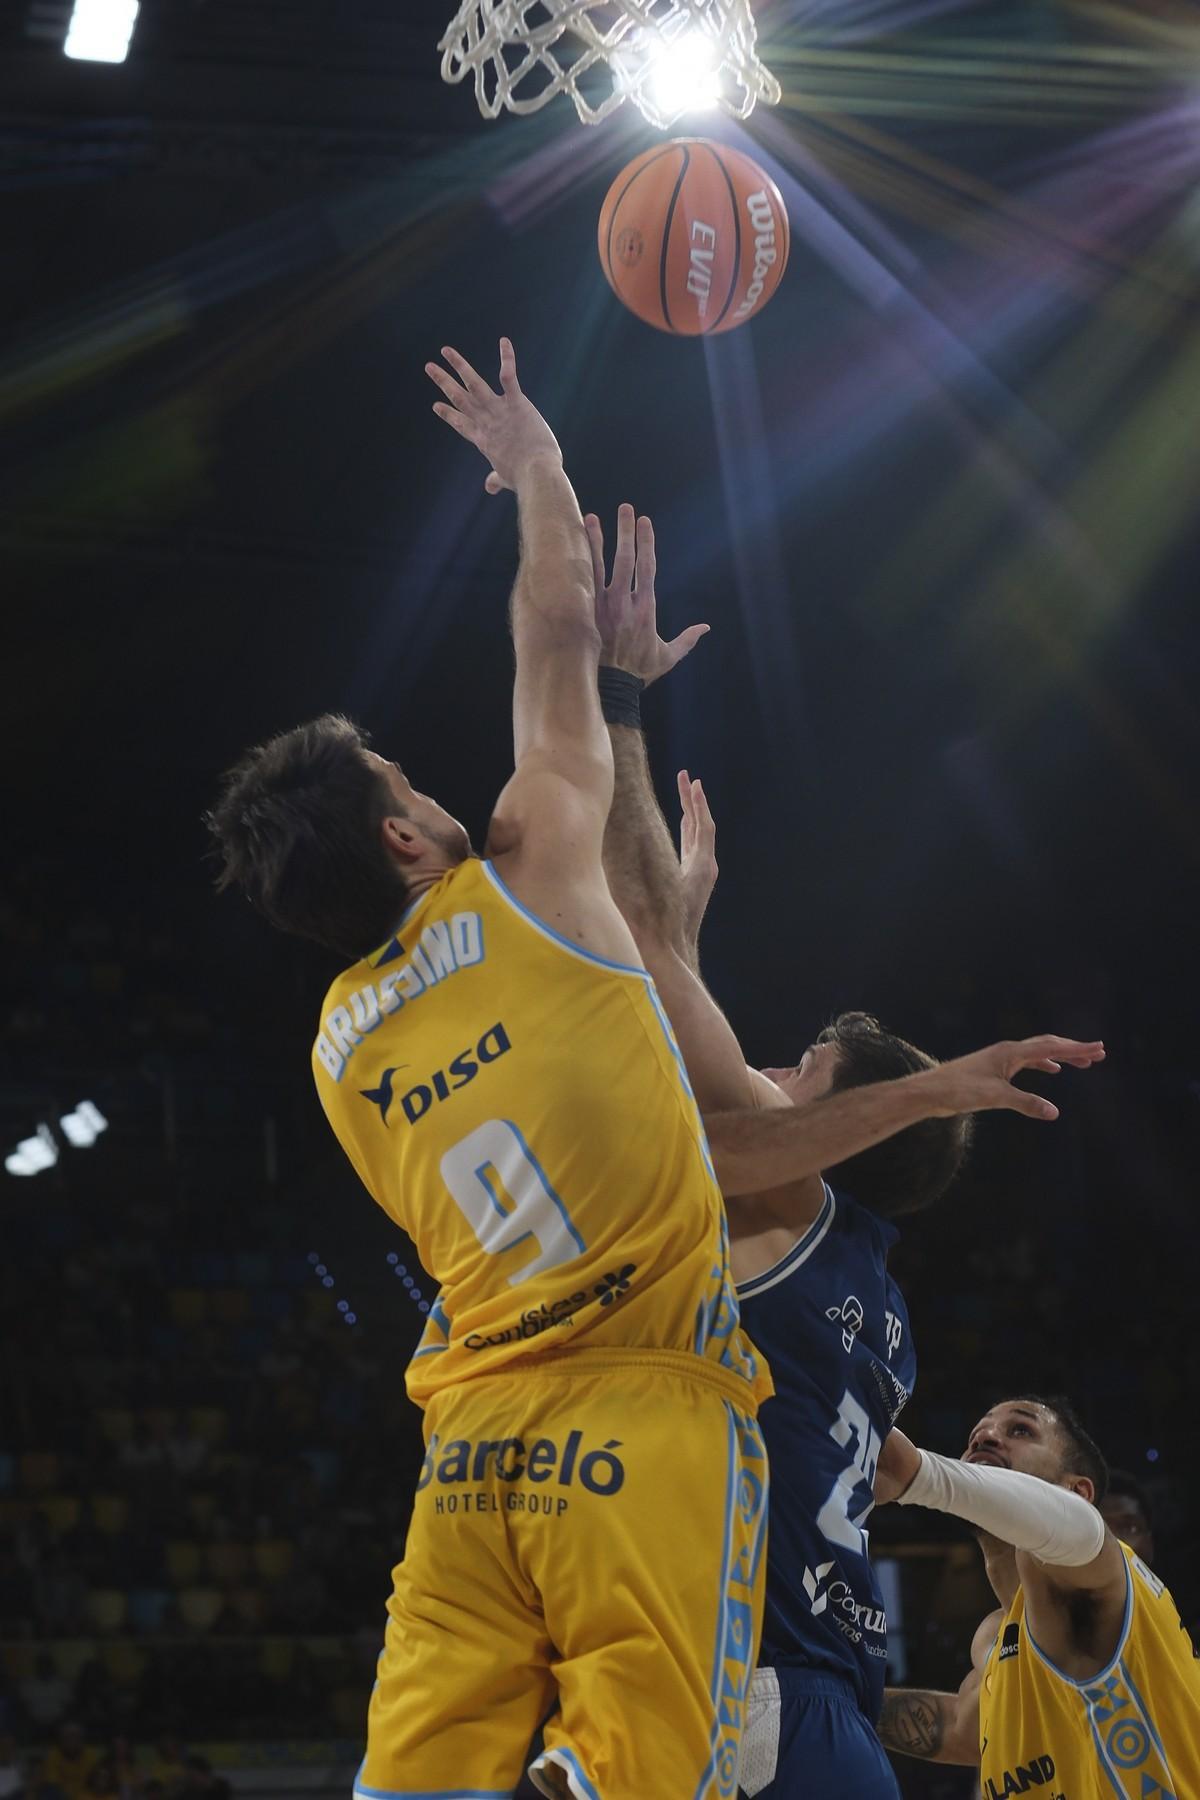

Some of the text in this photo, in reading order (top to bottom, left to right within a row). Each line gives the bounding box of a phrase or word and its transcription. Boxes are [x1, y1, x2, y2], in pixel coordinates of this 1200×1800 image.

[686, 219, 716, 298] EVO
[734, 189, 777, 319] Wilson
[439, 1119, 588, 1287] 9
[436, 1491, 569, 1517] HOTEL GROUP
[816, 1387, 882, 1560] 2
[827, 1580, 888, 1636] Coru
[984, 1753, 1056, 1800] LAND
